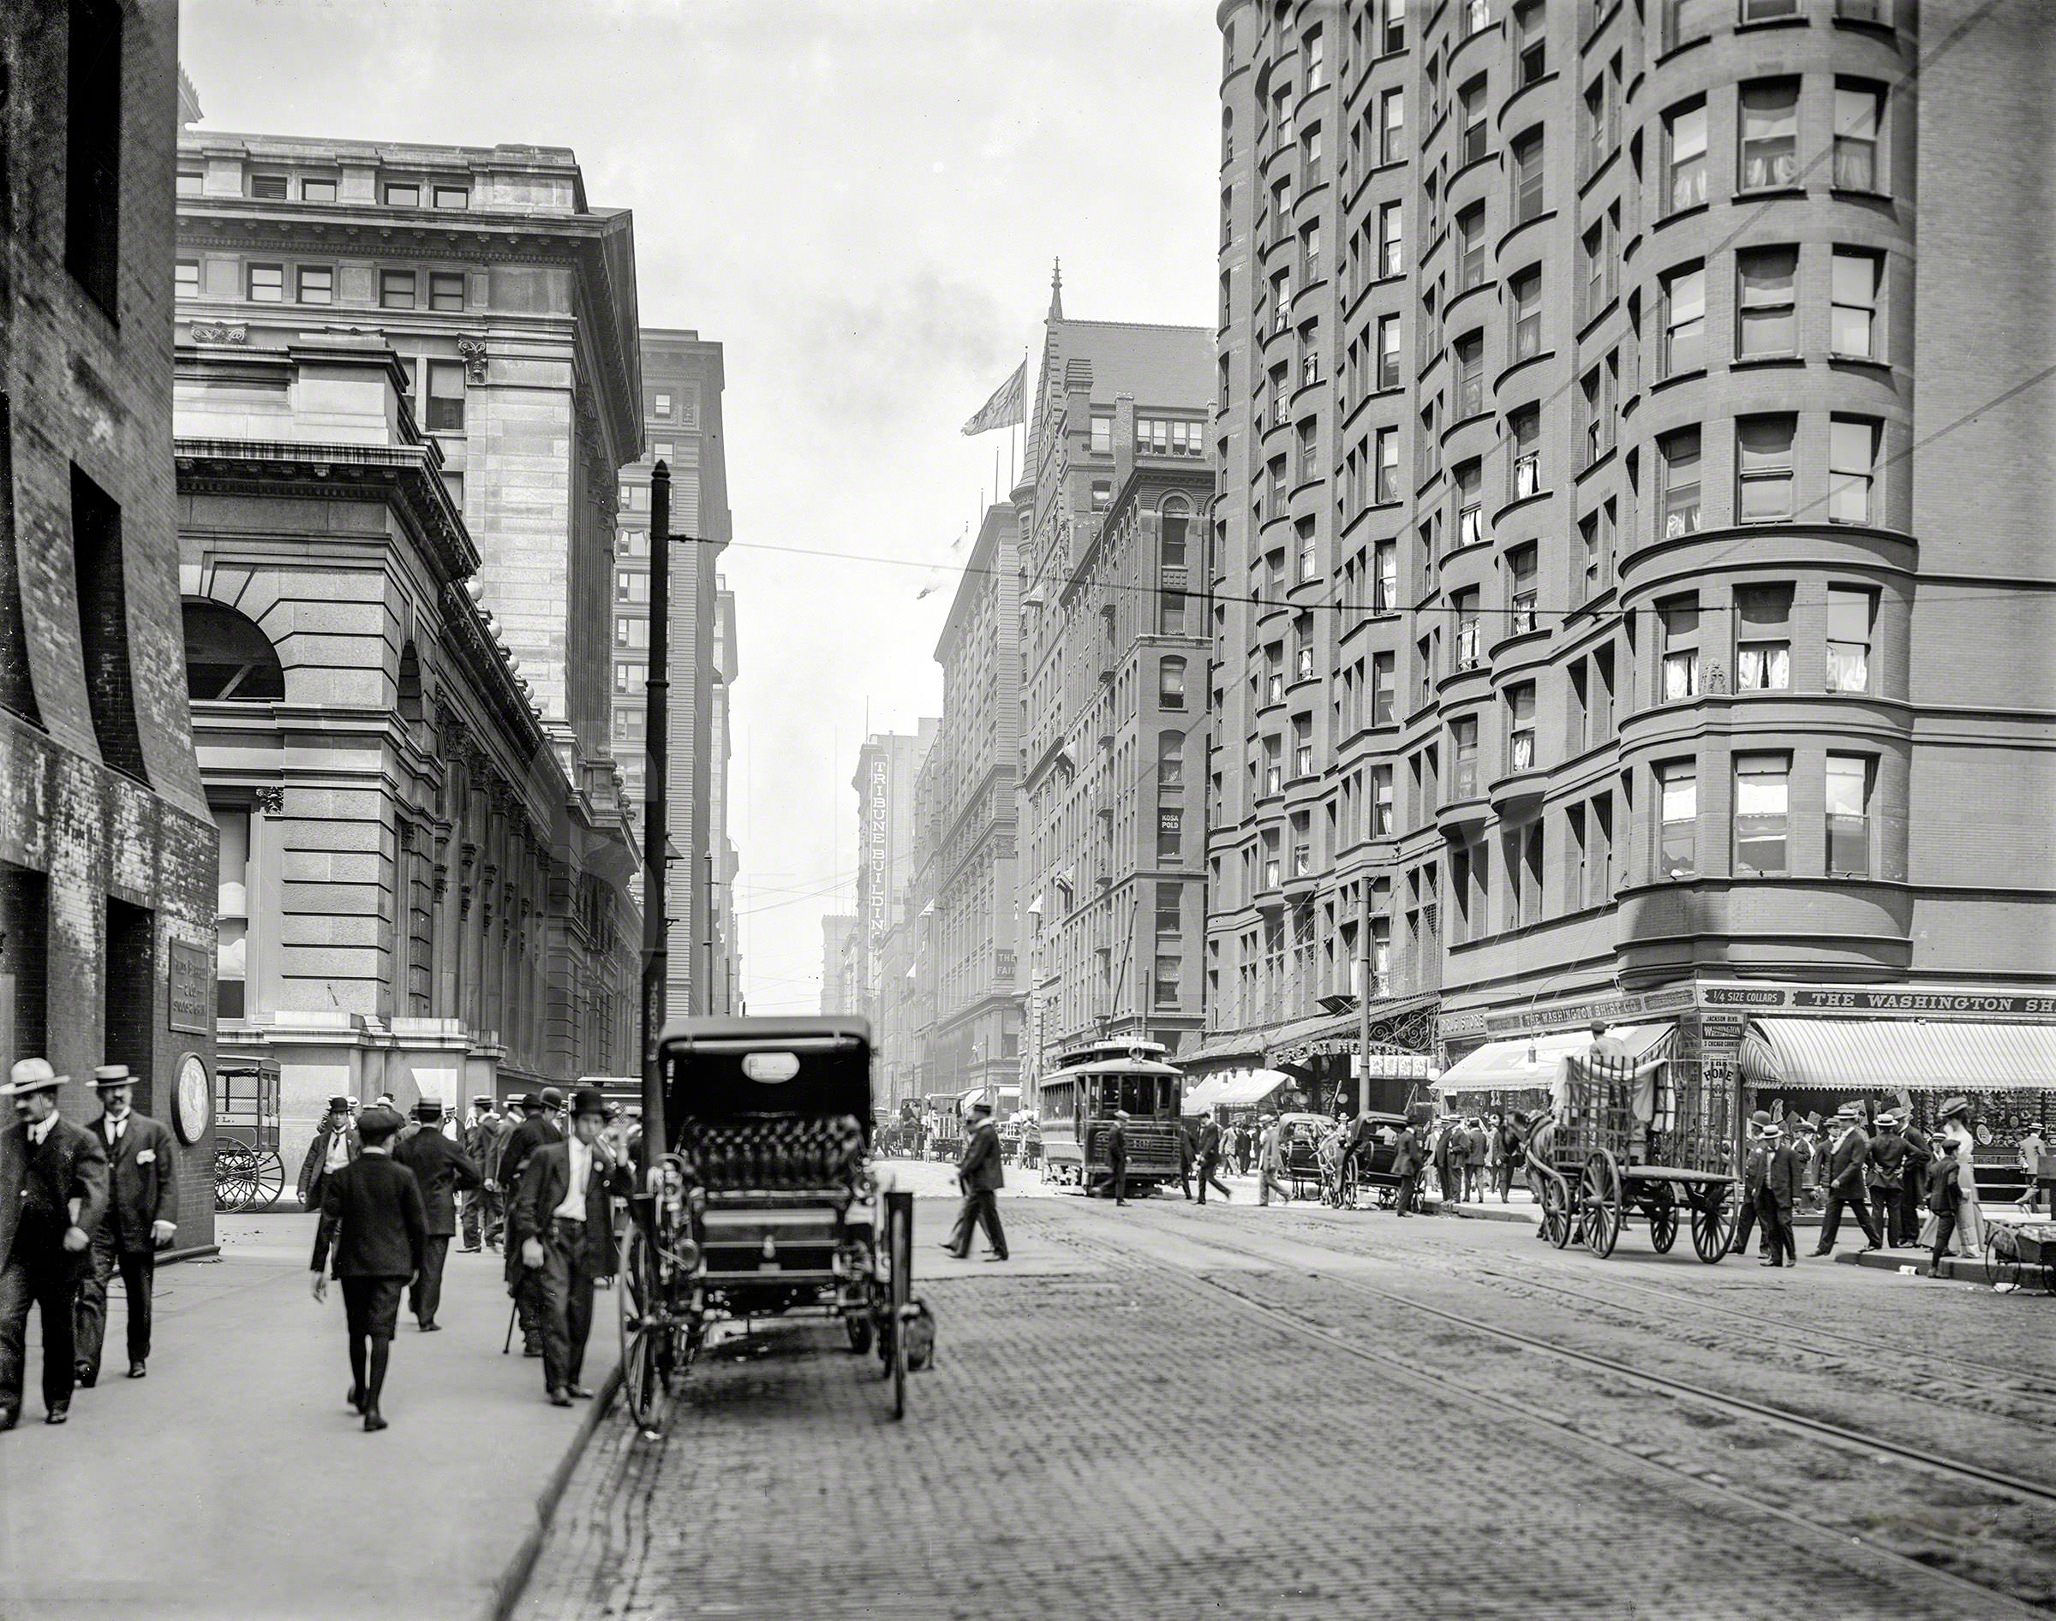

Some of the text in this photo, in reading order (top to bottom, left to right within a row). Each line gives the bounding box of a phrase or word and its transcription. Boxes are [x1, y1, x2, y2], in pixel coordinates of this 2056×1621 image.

[873, 761, 886, 844] TRIBUNE
[1727, 992, 1745, 1002] SIZE
[1746, 992, 1778, 1003] COLLARS
[1812, 993, 2056, 1012] THE WASHINGTON SH
[1525, 1012, 1541, 1027] THE
[1542, 1005, 1593, 1024] WASHINGTON
[1595, 1001, 1621, 1017] SHIRT
[1274, 1040, 1329, 1066] GREAT
